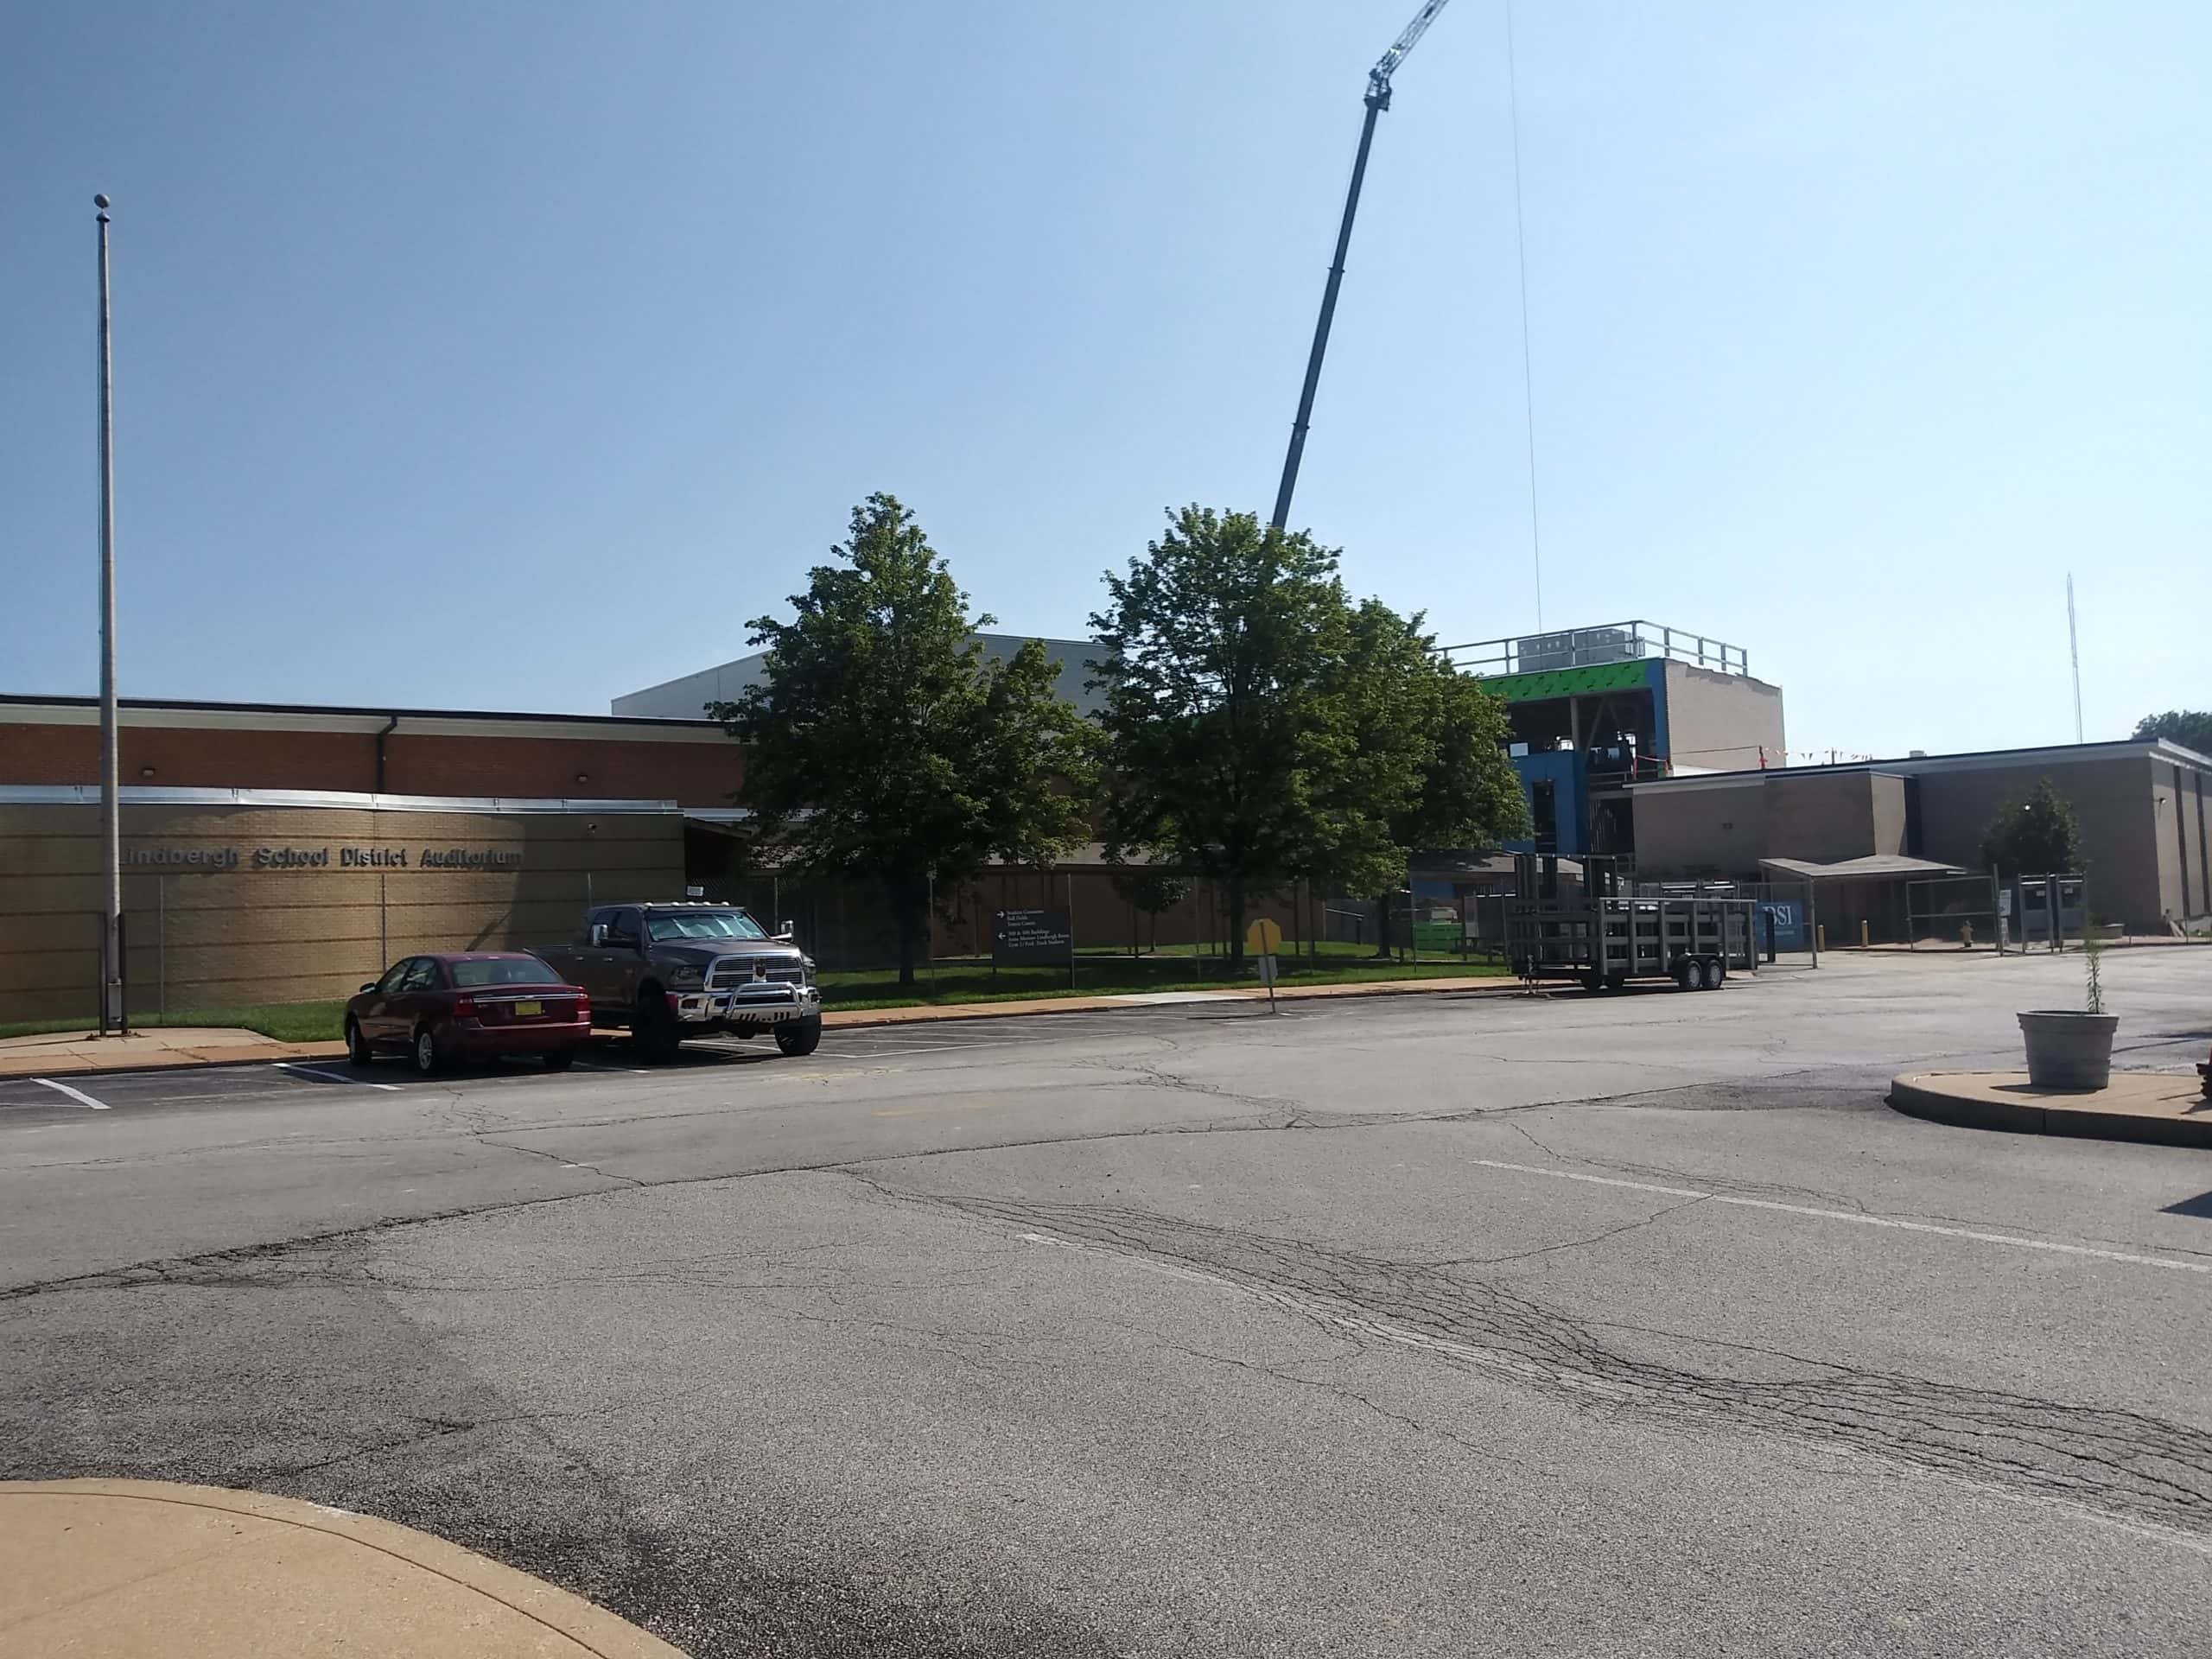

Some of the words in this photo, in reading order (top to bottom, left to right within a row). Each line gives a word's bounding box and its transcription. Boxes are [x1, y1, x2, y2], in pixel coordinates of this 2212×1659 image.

[118, 848, 239, 868] indbergh
[257, 847, 328, 867] School
[340, 847, 408, 867] District
[421, 849, 524, 867] Auditorium
